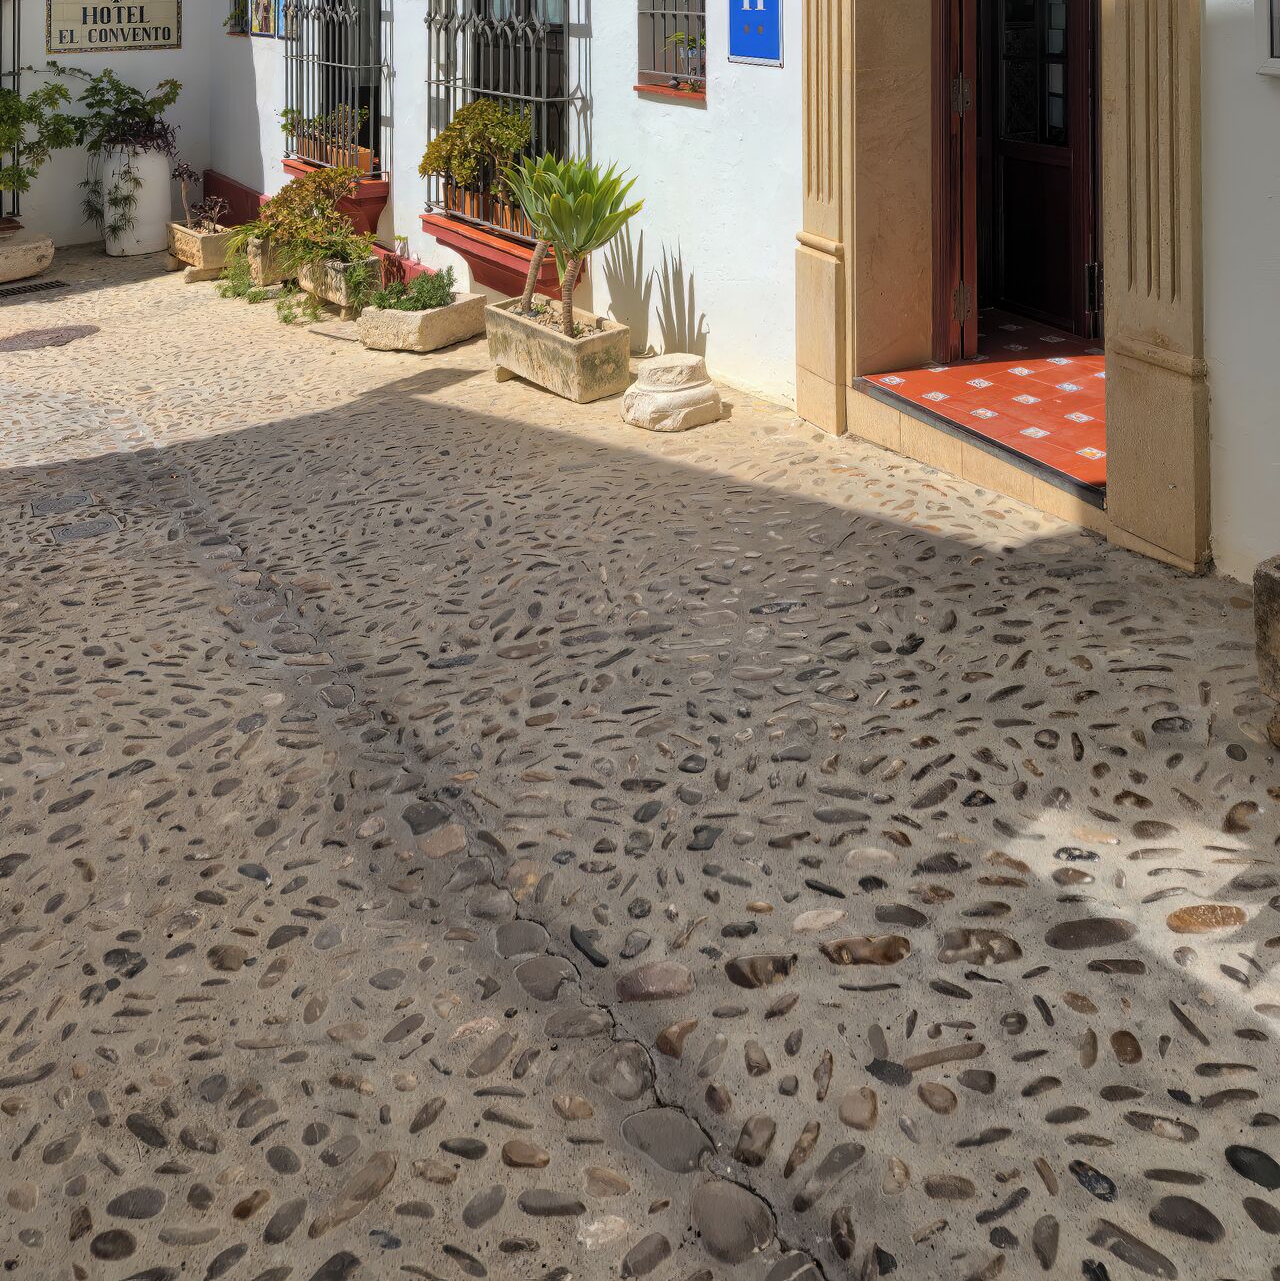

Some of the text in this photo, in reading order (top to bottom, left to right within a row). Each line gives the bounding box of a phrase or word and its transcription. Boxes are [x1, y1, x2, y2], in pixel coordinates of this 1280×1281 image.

[81, 5, 151, 25] HOTEL
[58, 26, 171, 45] EL CONVENTO
